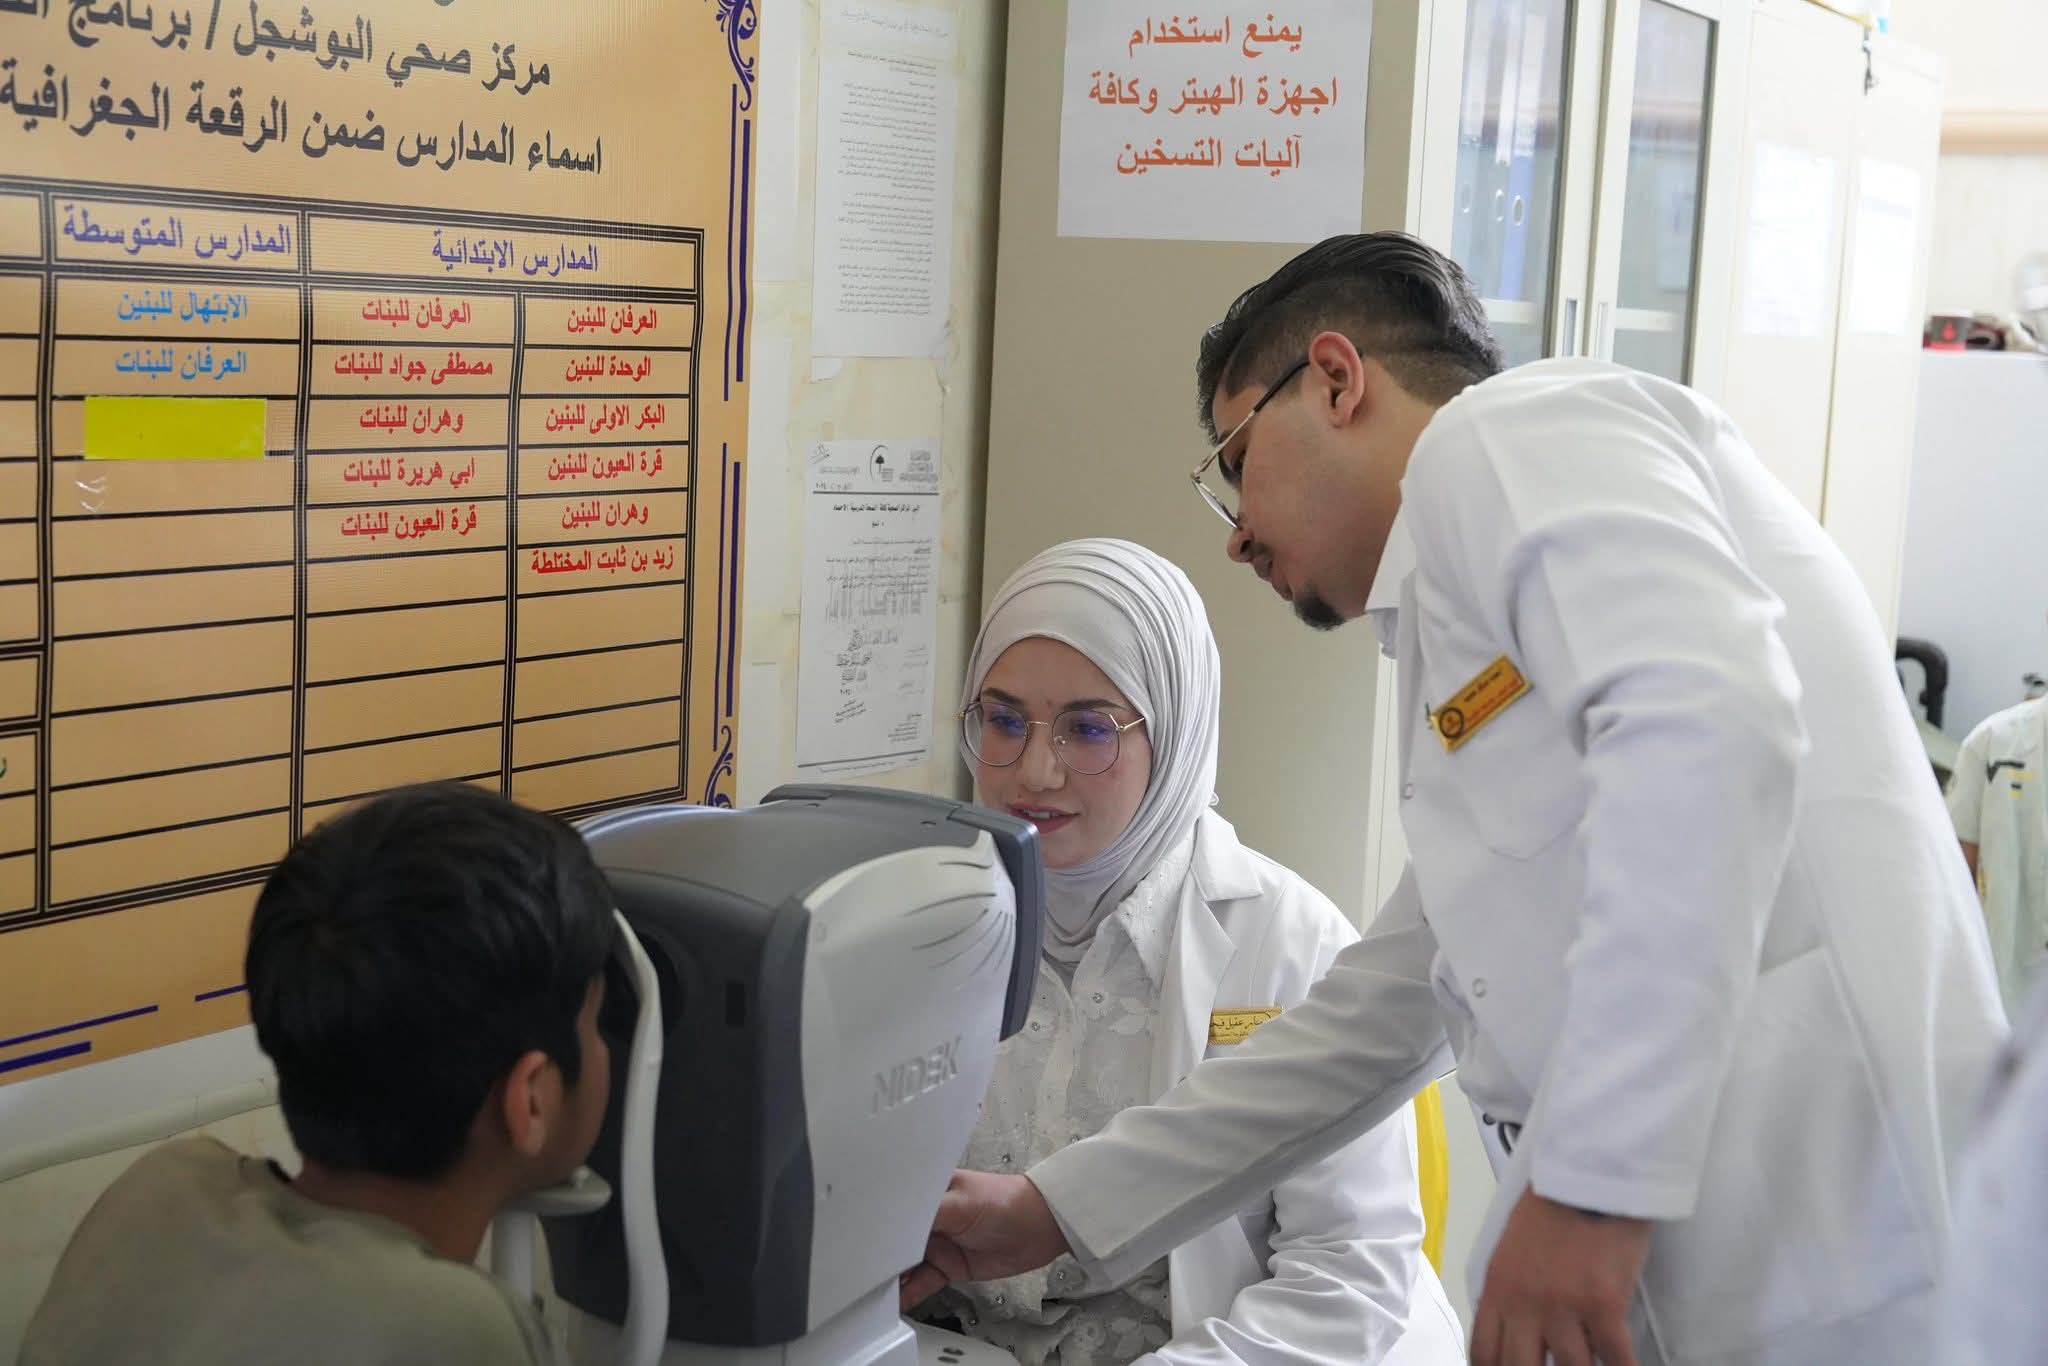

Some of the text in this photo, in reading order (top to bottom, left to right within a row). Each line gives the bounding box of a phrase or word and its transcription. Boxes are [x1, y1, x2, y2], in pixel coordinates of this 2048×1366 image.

[233, 5, 372, 71] البوشجل
[1129, 14, 1302, 58] يمنع استخدام
[386, 43, 471, 88] صحي
[481, 43, 550, 95] مركز
[1089, 71, 1337, 116] اجهزة الهيتر وكافة
[0, 58, 601, 174] اسماء المدارس ضمن الرقعة الجغرافية
[1117, 137, 1221, 174] التسخين
[64, 204, 291, 261] المدارس المتوسطة
[433, 229, 598, 277] المدارس الابتدائية
[118, 291, 247, 324] الابتهال للبنين
[362, 296, 471, 329] العرفان للبنات
[568, 304, 658, 335] العرفان للبنين
[116, 346, 246, 380] العرفان للبنات
[335, 352, 492, 385] مصطفى جواد للبنات
[566, 355, 650, 382] الوحدة للبنين
[360, 405, 463, 434] وهران للبنات
[546, 403, 665, 434] البكر الاولى للبنين
[344, 457, 475, 489] ابي هريرة للبنات
[548, 449, 662, 480] قرة العيون للبنين
[342, 503, 476, 540] قرة العيون للبنات
[562, 501, 648, 529] وهران للبنين
[530, 545, 674, 574] زيد بن ثابت المختلطة
[870, 1036, 962, 1114] NIDEK
